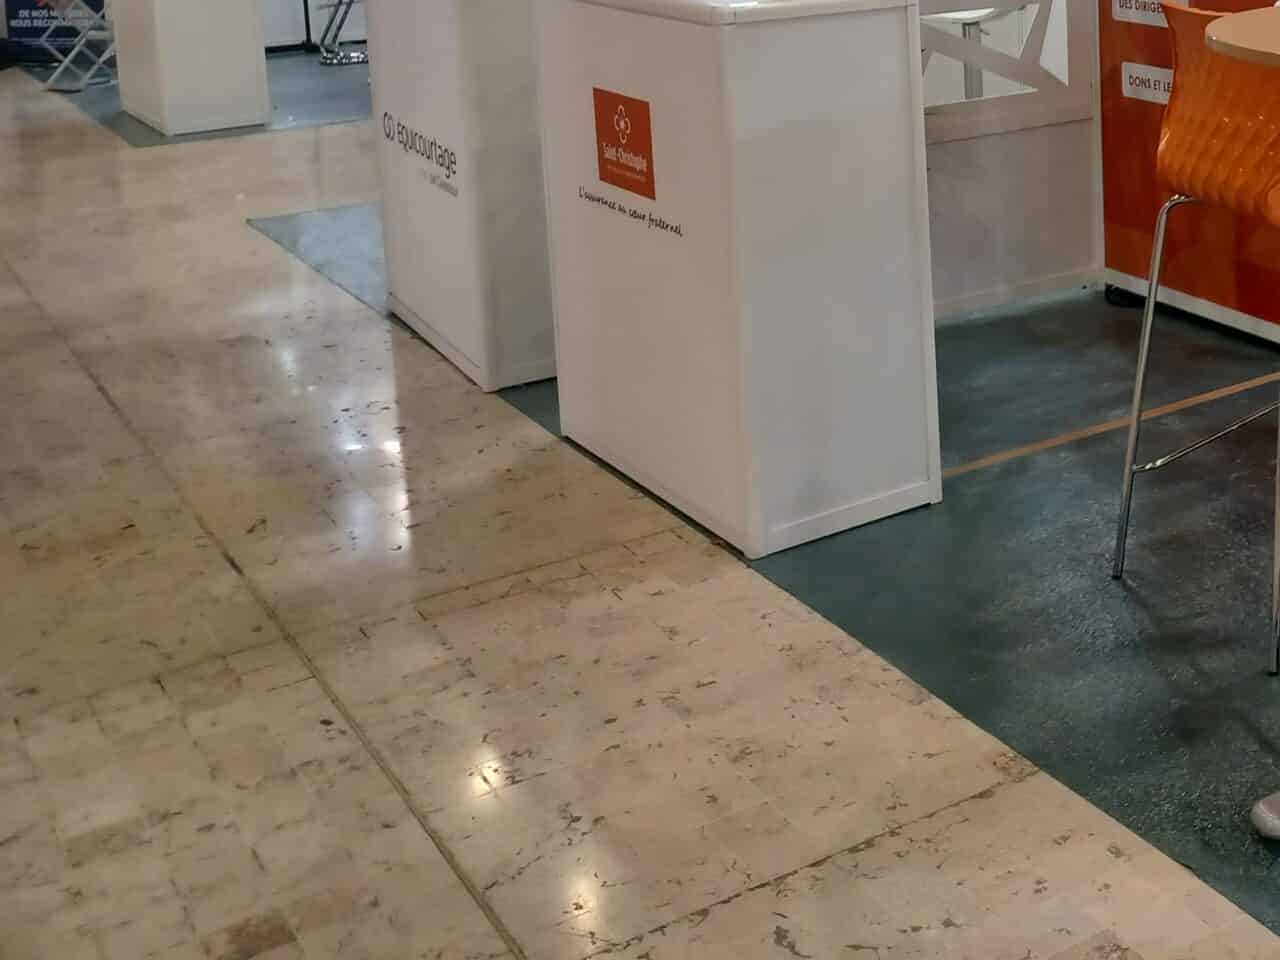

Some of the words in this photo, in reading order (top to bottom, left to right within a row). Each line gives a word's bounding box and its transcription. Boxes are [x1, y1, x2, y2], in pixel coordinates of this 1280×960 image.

[1135, 0, 1162, 14] DIRIGE
[1128, 74, 1151, 90] DONS
[1153, 78, 1162, 91] ET
[1163, 79, 1172, 92] LE
